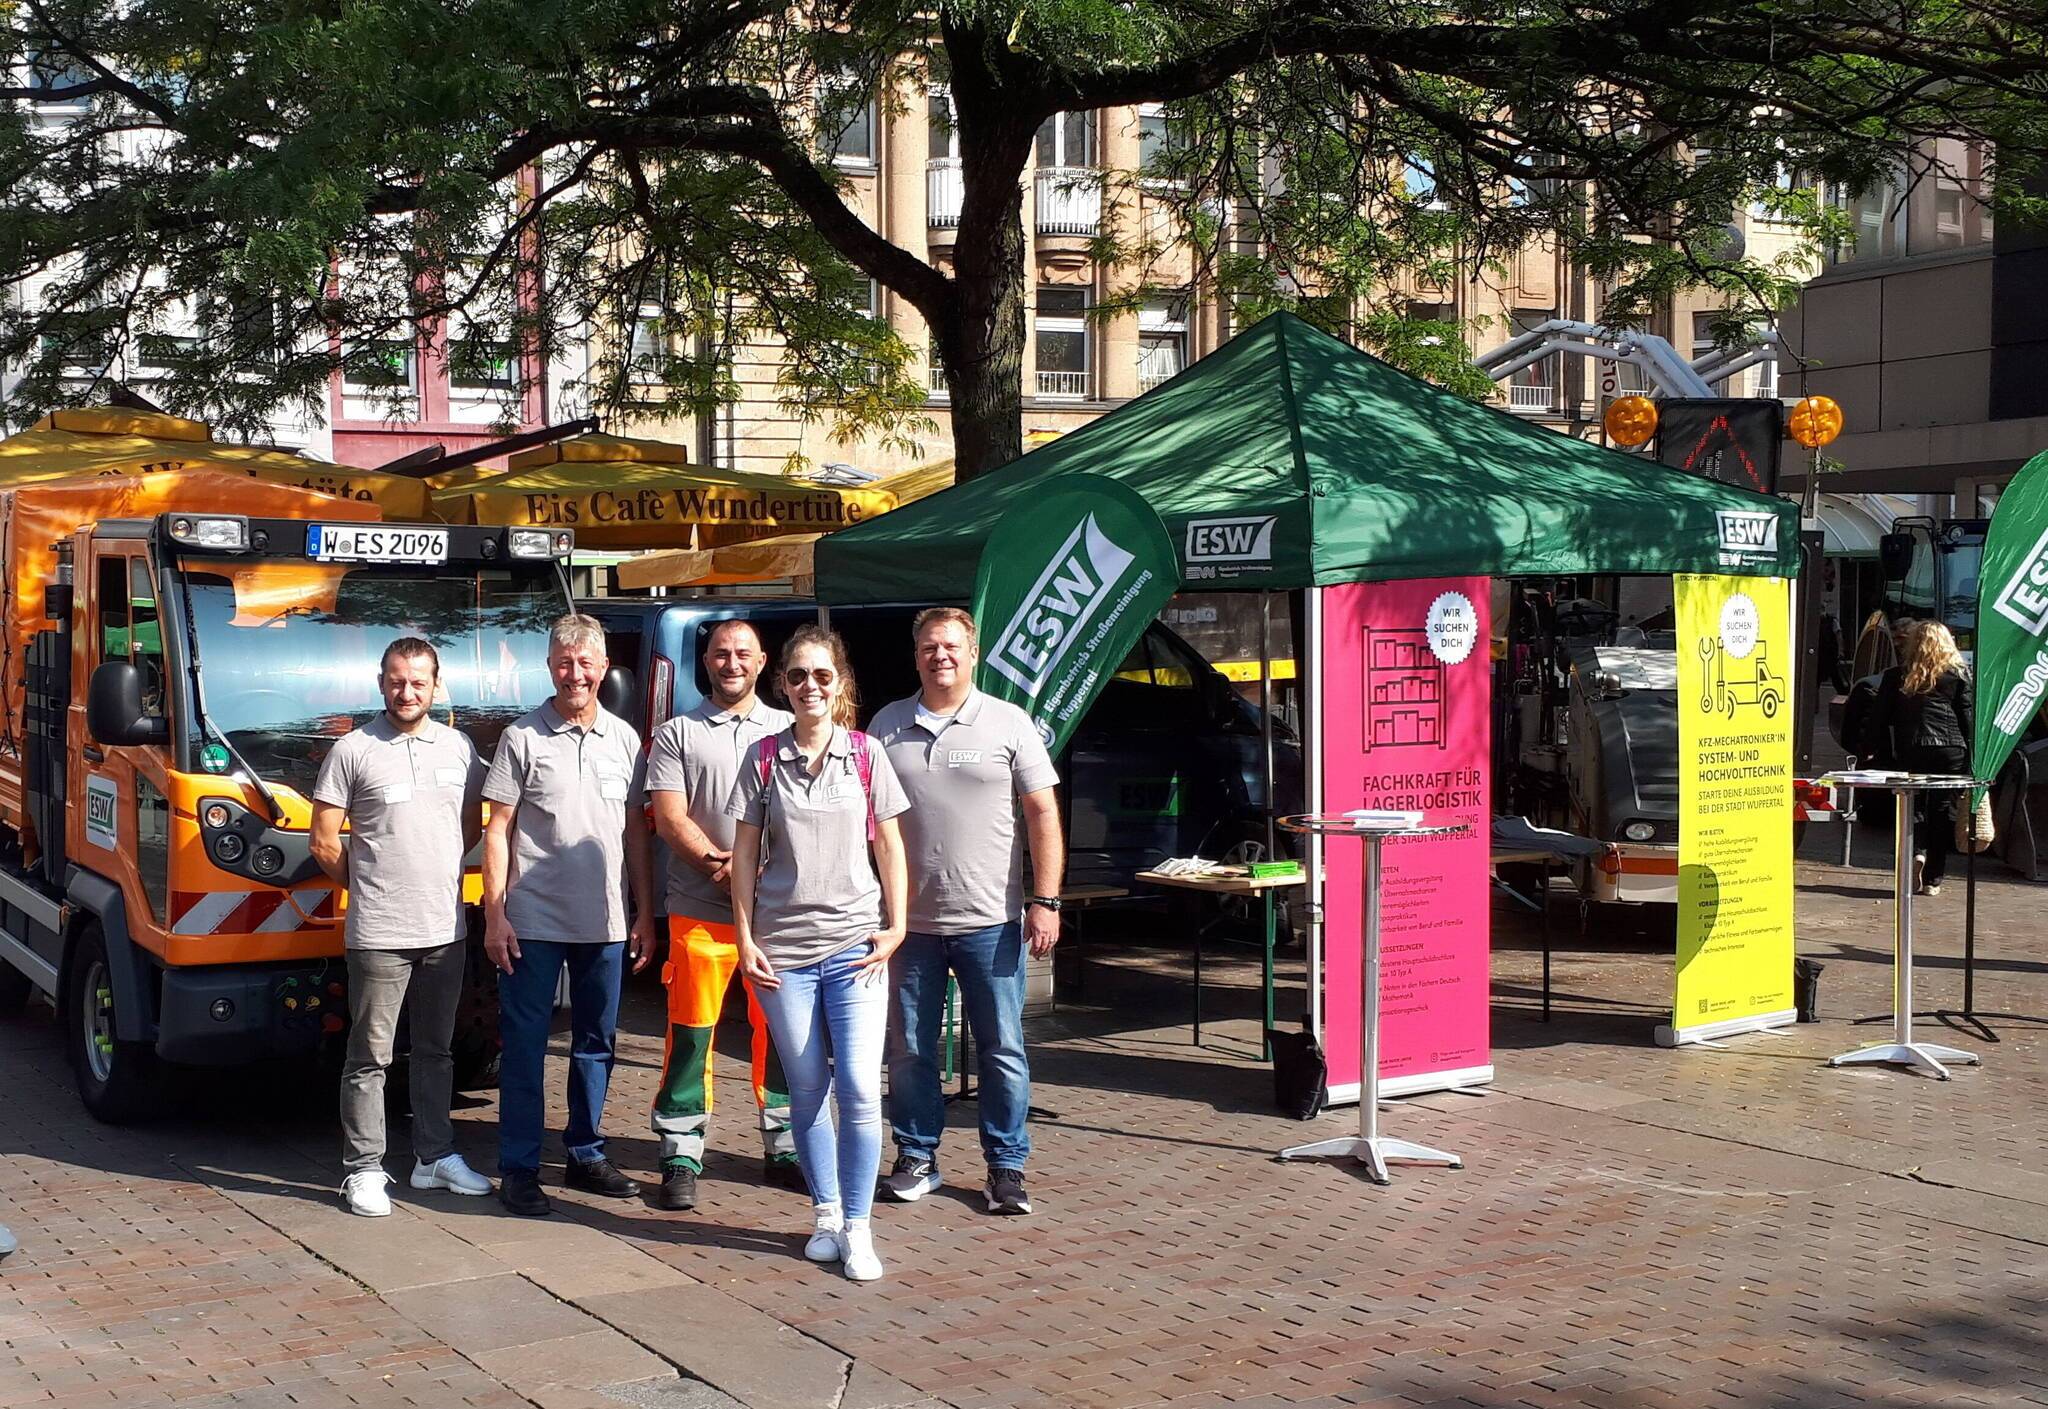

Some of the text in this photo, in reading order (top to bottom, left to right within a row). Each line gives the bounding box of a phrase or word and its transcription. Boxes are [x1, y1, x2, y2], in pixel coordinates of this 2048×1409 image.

[527, 493, 579, 525] Eis
[673, 488, 862, 522] Wundertüte
[1196, 525, 1254, 554] ESW
[1724, 518, 1765, 544] ESW
[324, 532, 444, 555] W ES 2096
[1007, 555, 1096, 674] ESW
[1443, 608, 1461, 617] WIR
[1733, 608, 1746, 616] WIR
[1433, 623, 1469, 632] SUCHEN
[1726, 622, 1752, 630] SUCHEN
[1043, 569, 1153, 713] Eigenbetrieb Straßenreinigung
[1441, 638, 1463, 647] DICH
[1057, 668, 1099, 721] Wuppertal
[1698, 749, 1759, 765] SYSTEM- UND
[1363, 766, 1481, 792] FACHKRAFT FÜR
[1698, 764, 1786, 782] HOCHVOLTTECHNIK
[1698, 784, 1784, 800] STARTE DEINE AUSBILDUNG
[90, 795, 108, 822] ESW
[1698, 798, 1785, 814] BEI DER STADT WUPPERTAL
[1380, 943, 1424, 954] USSETZUNGEN
